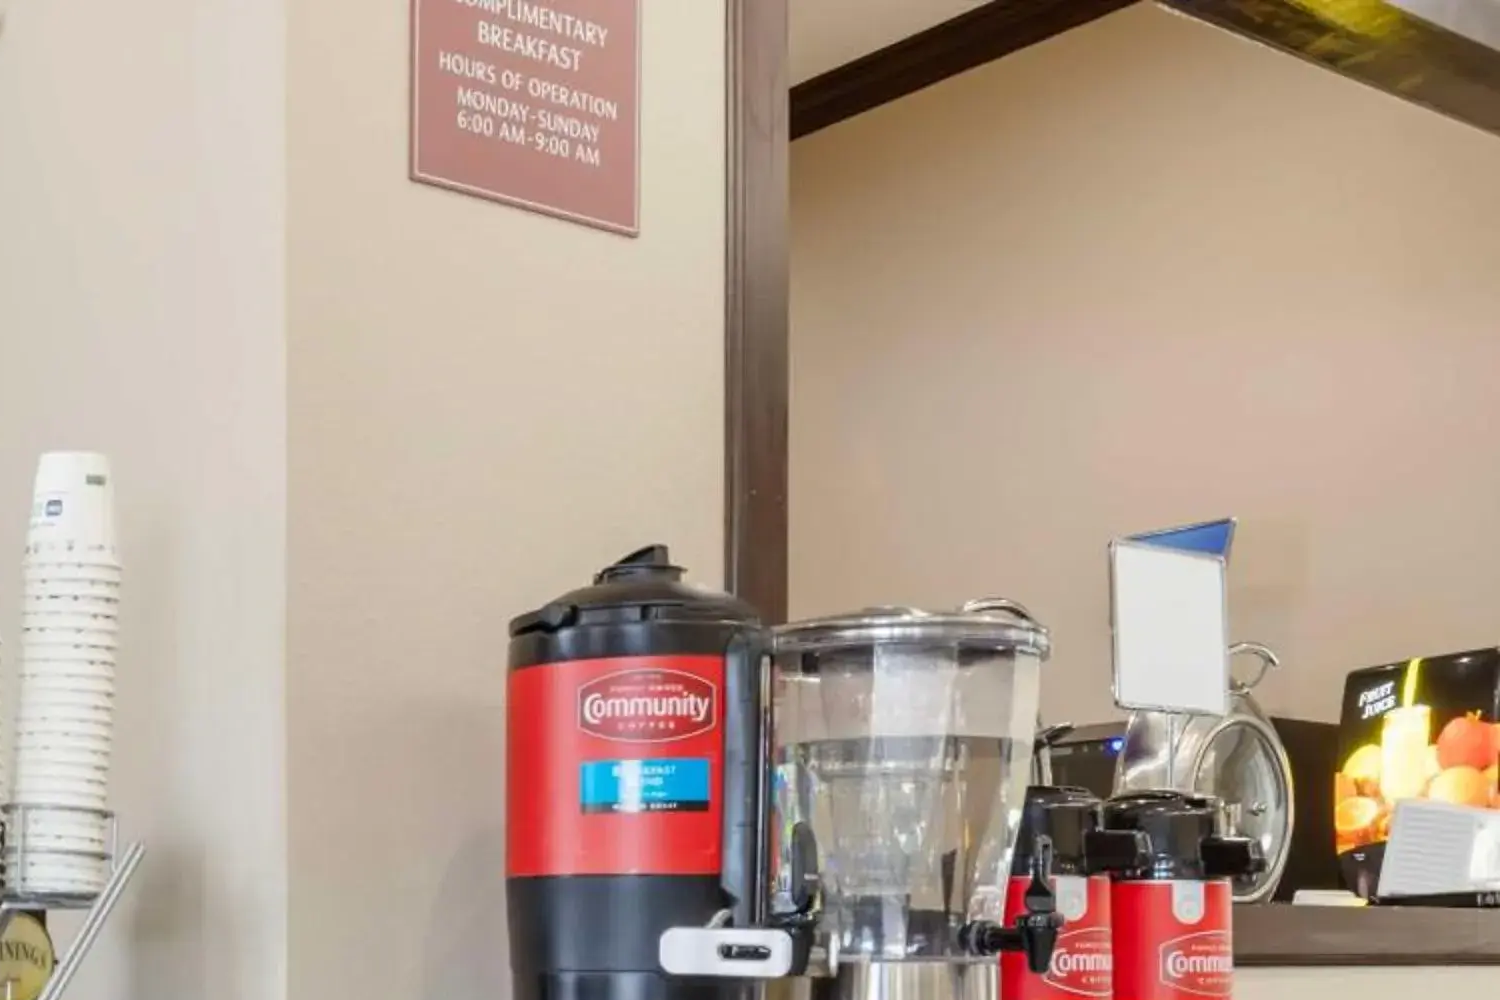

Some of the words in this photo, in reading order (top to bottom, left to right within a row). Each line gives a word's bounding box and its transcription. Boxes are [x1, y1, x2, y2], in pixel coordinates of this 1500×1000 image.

[455, 0, 608, 47] MPLIMENTARY
[477, 20, 582, 72] BREAKFAST
[439, 51, 496, 84] HOURS
[501, 69, 523, 91] OF
[528, 77, 618, 120] OPERATION
[457, 110, 493, 136] 6:00
[575, 144, 600, 166] AM
[583, 692, 709, 724] Community
